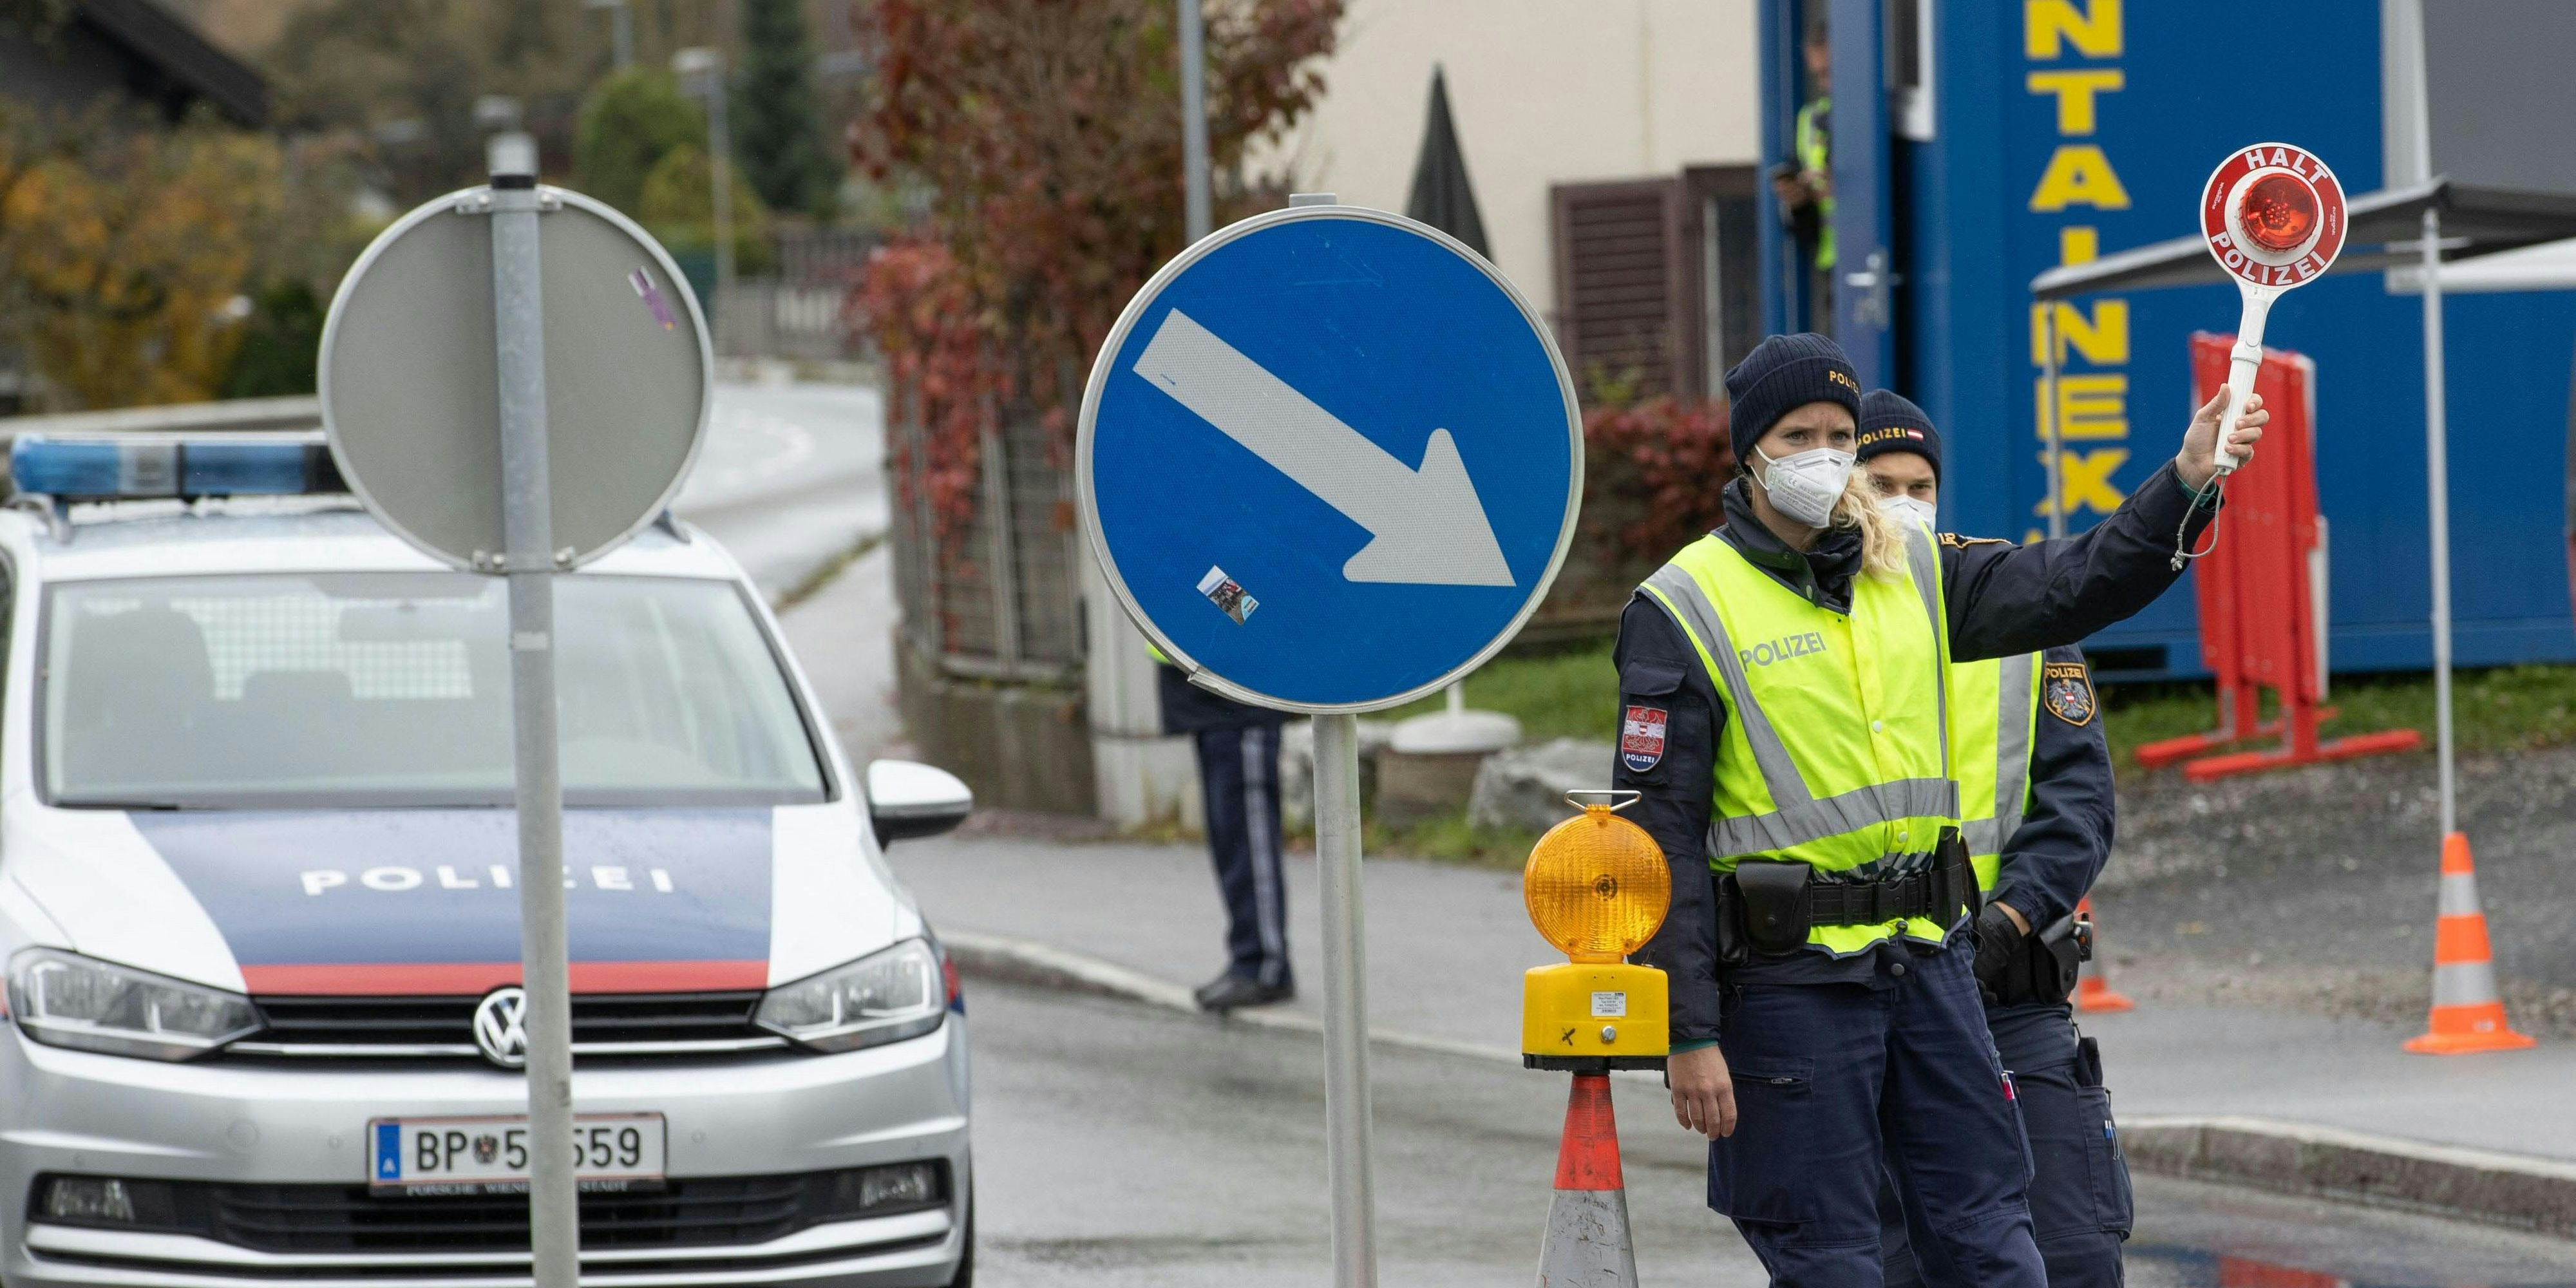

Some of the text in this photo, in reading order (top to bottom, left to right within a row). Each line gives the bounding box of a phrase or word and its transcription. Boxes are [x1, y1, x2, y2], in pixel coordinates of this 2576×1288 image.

[2245, 148, 2329, 184] HALT
[2210, 231, 2326, 285] POLIZEI
[1829, 370, 1859, 395] POLIZ
[1739, 632, 1826, 672] POLIZEI
[1626, 753, 1654, 763] POLIZEI
[300, 864, 674, 896] POLIEI
[382, 1157, 397, 1173] A
[416, 1132, 468, 1172] BP
